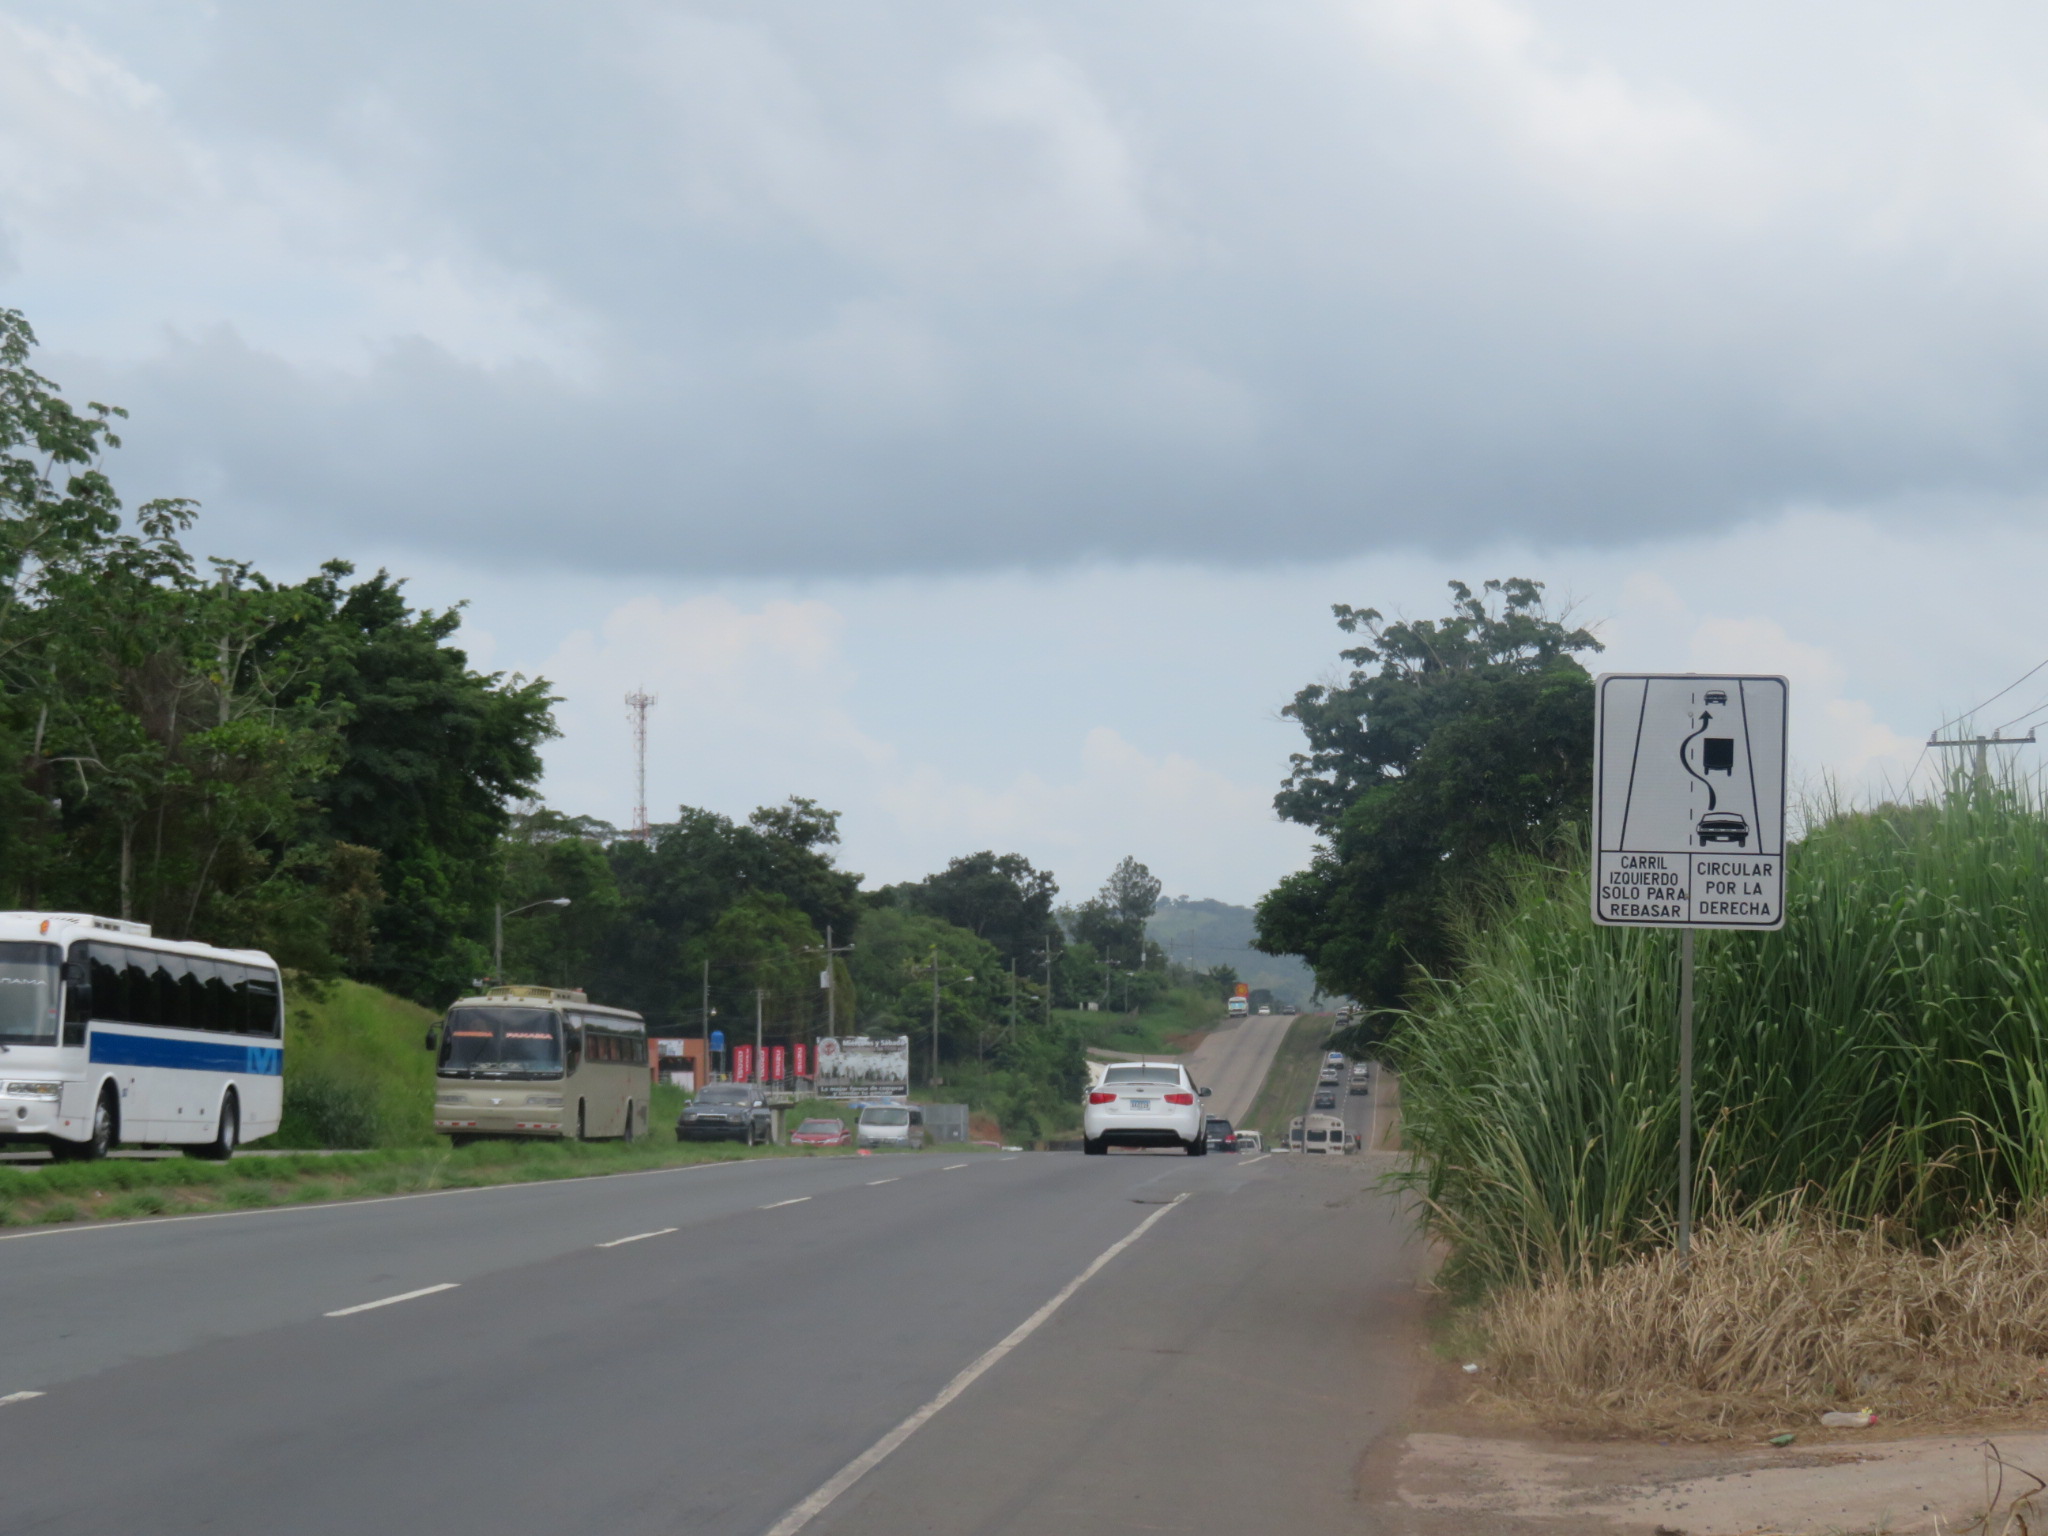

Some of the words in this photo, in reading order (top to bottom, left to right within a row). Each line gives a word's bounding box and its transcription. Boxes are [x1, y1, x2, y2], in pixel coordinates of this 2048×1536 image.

[1620, 856, 1668, 870] CARRIL
[1697, 862, 1773, 877] CIRCULAR
[1610, 872, 1679, 886] IZQUIERDO
[1602, 887, 1640, 900] SOLO
[1647, 888, 1686, 901] PARA
[1706, 881, 1736, 895] POR
[1743, 882, 1763, 895] LA
[1610, 904, 1681, 917] REBASAR
[1699, 901, 1771, 916] DERECHA
